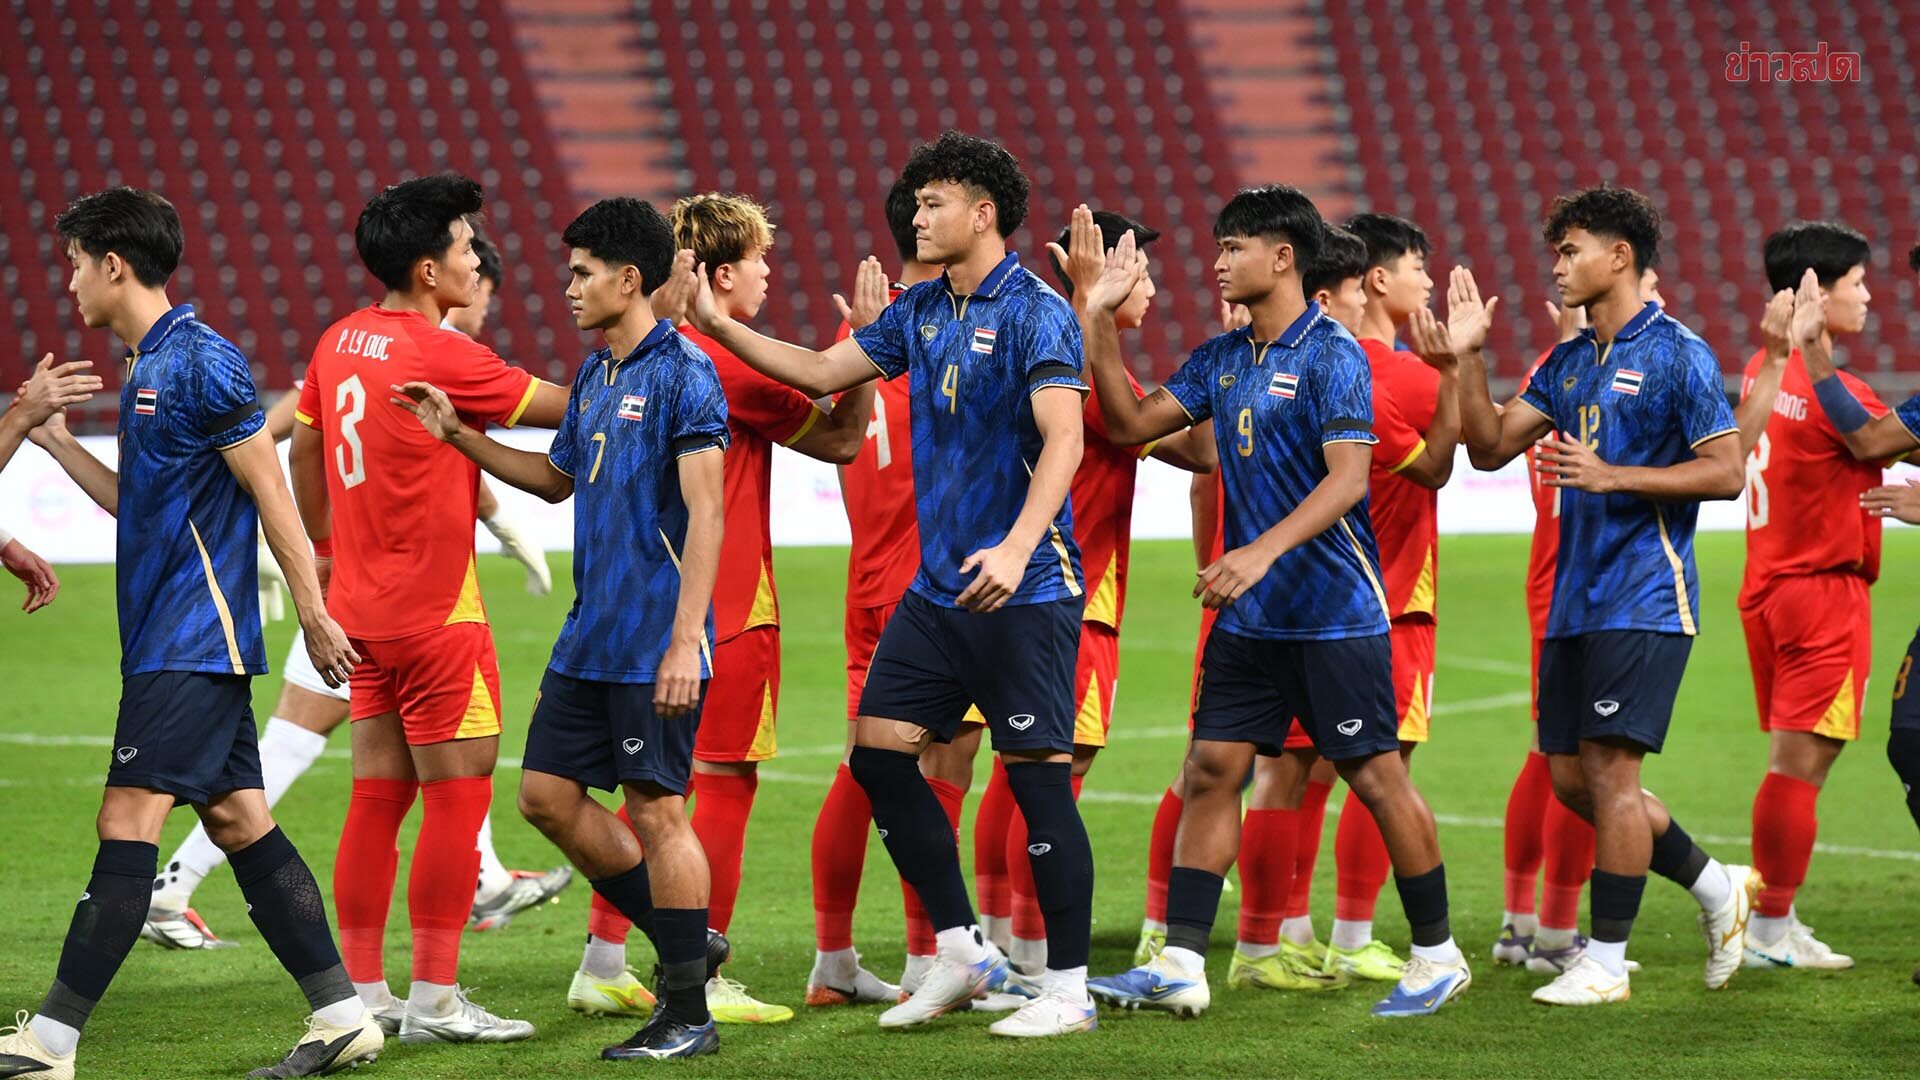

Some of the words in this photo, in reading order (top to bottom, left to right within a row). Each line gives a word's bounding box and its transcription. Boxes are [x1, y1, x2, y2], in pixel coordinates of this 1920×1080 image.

[941, 364, 959, 415] 4
[335, 373, 367, 490] 3
[1237, 408, 1253, 457] 9
[1578, 404, 1600, 453] 12
[588, 432, 606, 484] 7
[1745, 430, 1771, 531] 8
